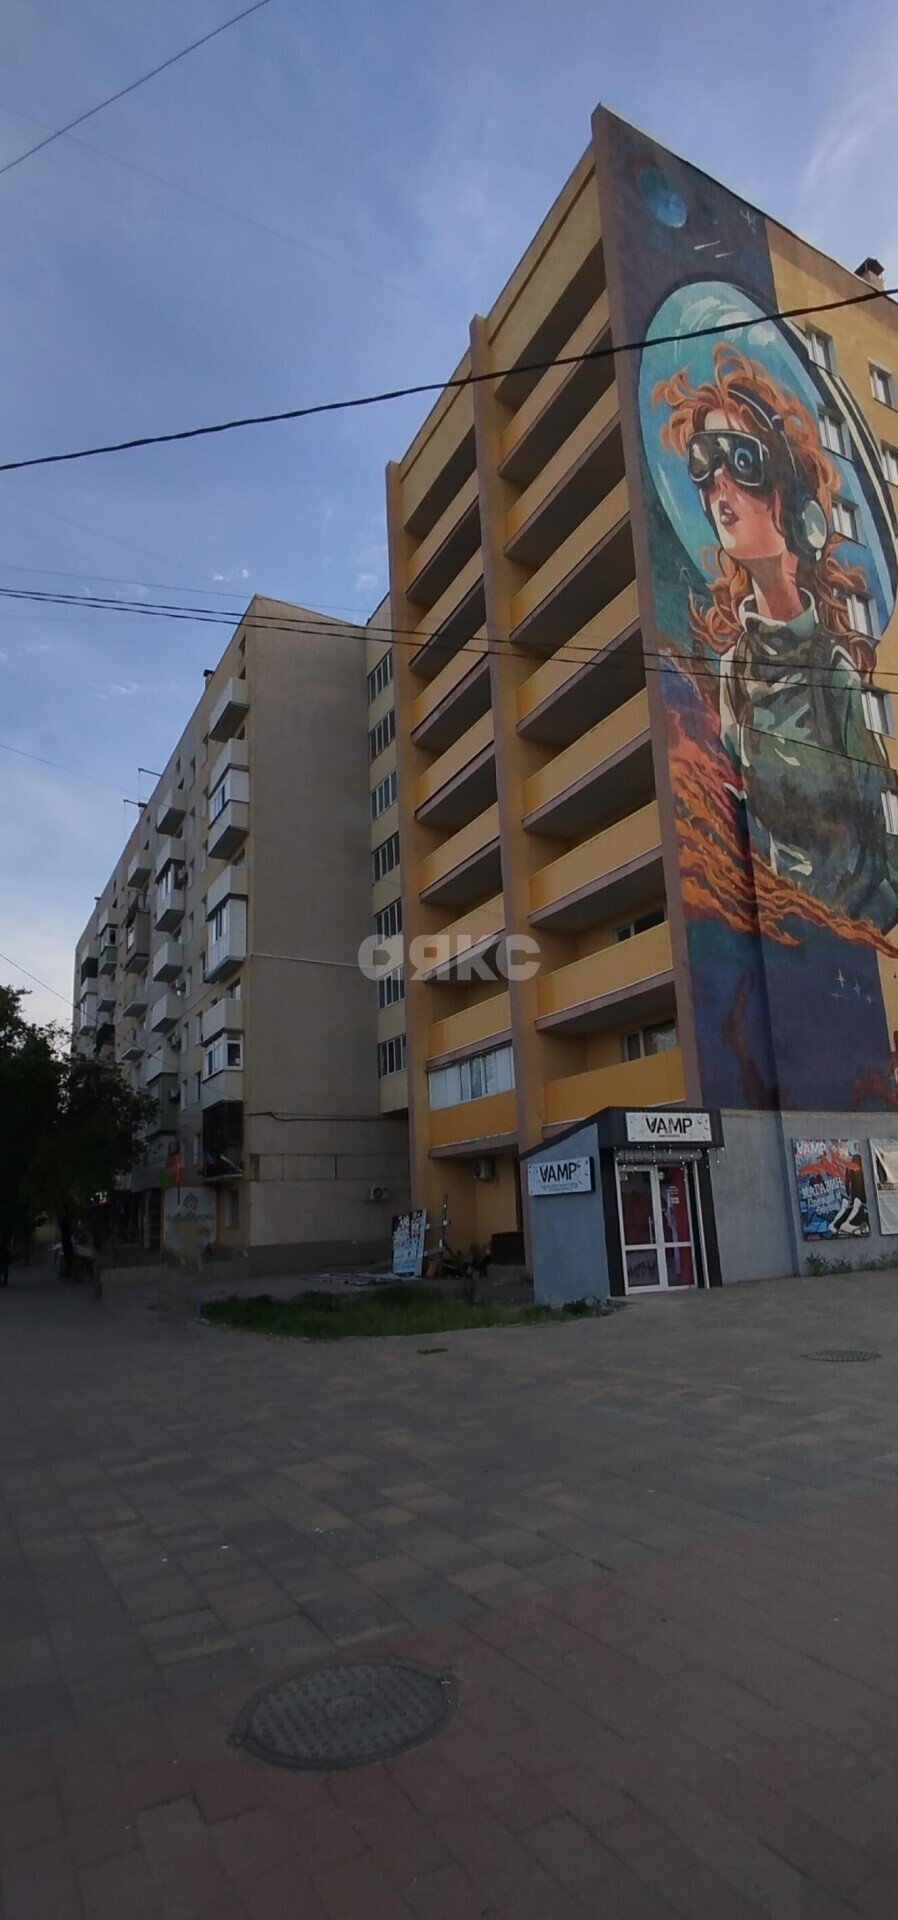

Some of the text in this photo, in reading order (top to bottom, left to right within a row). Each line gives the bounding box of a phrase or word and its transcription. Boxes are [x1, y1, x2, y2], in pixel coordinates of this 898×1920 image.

[646, 1117, 692, 1134] VAMP
[796, 1142, 826, 1155] VAMP
[540, 1162, 577, 1183] VAMP
